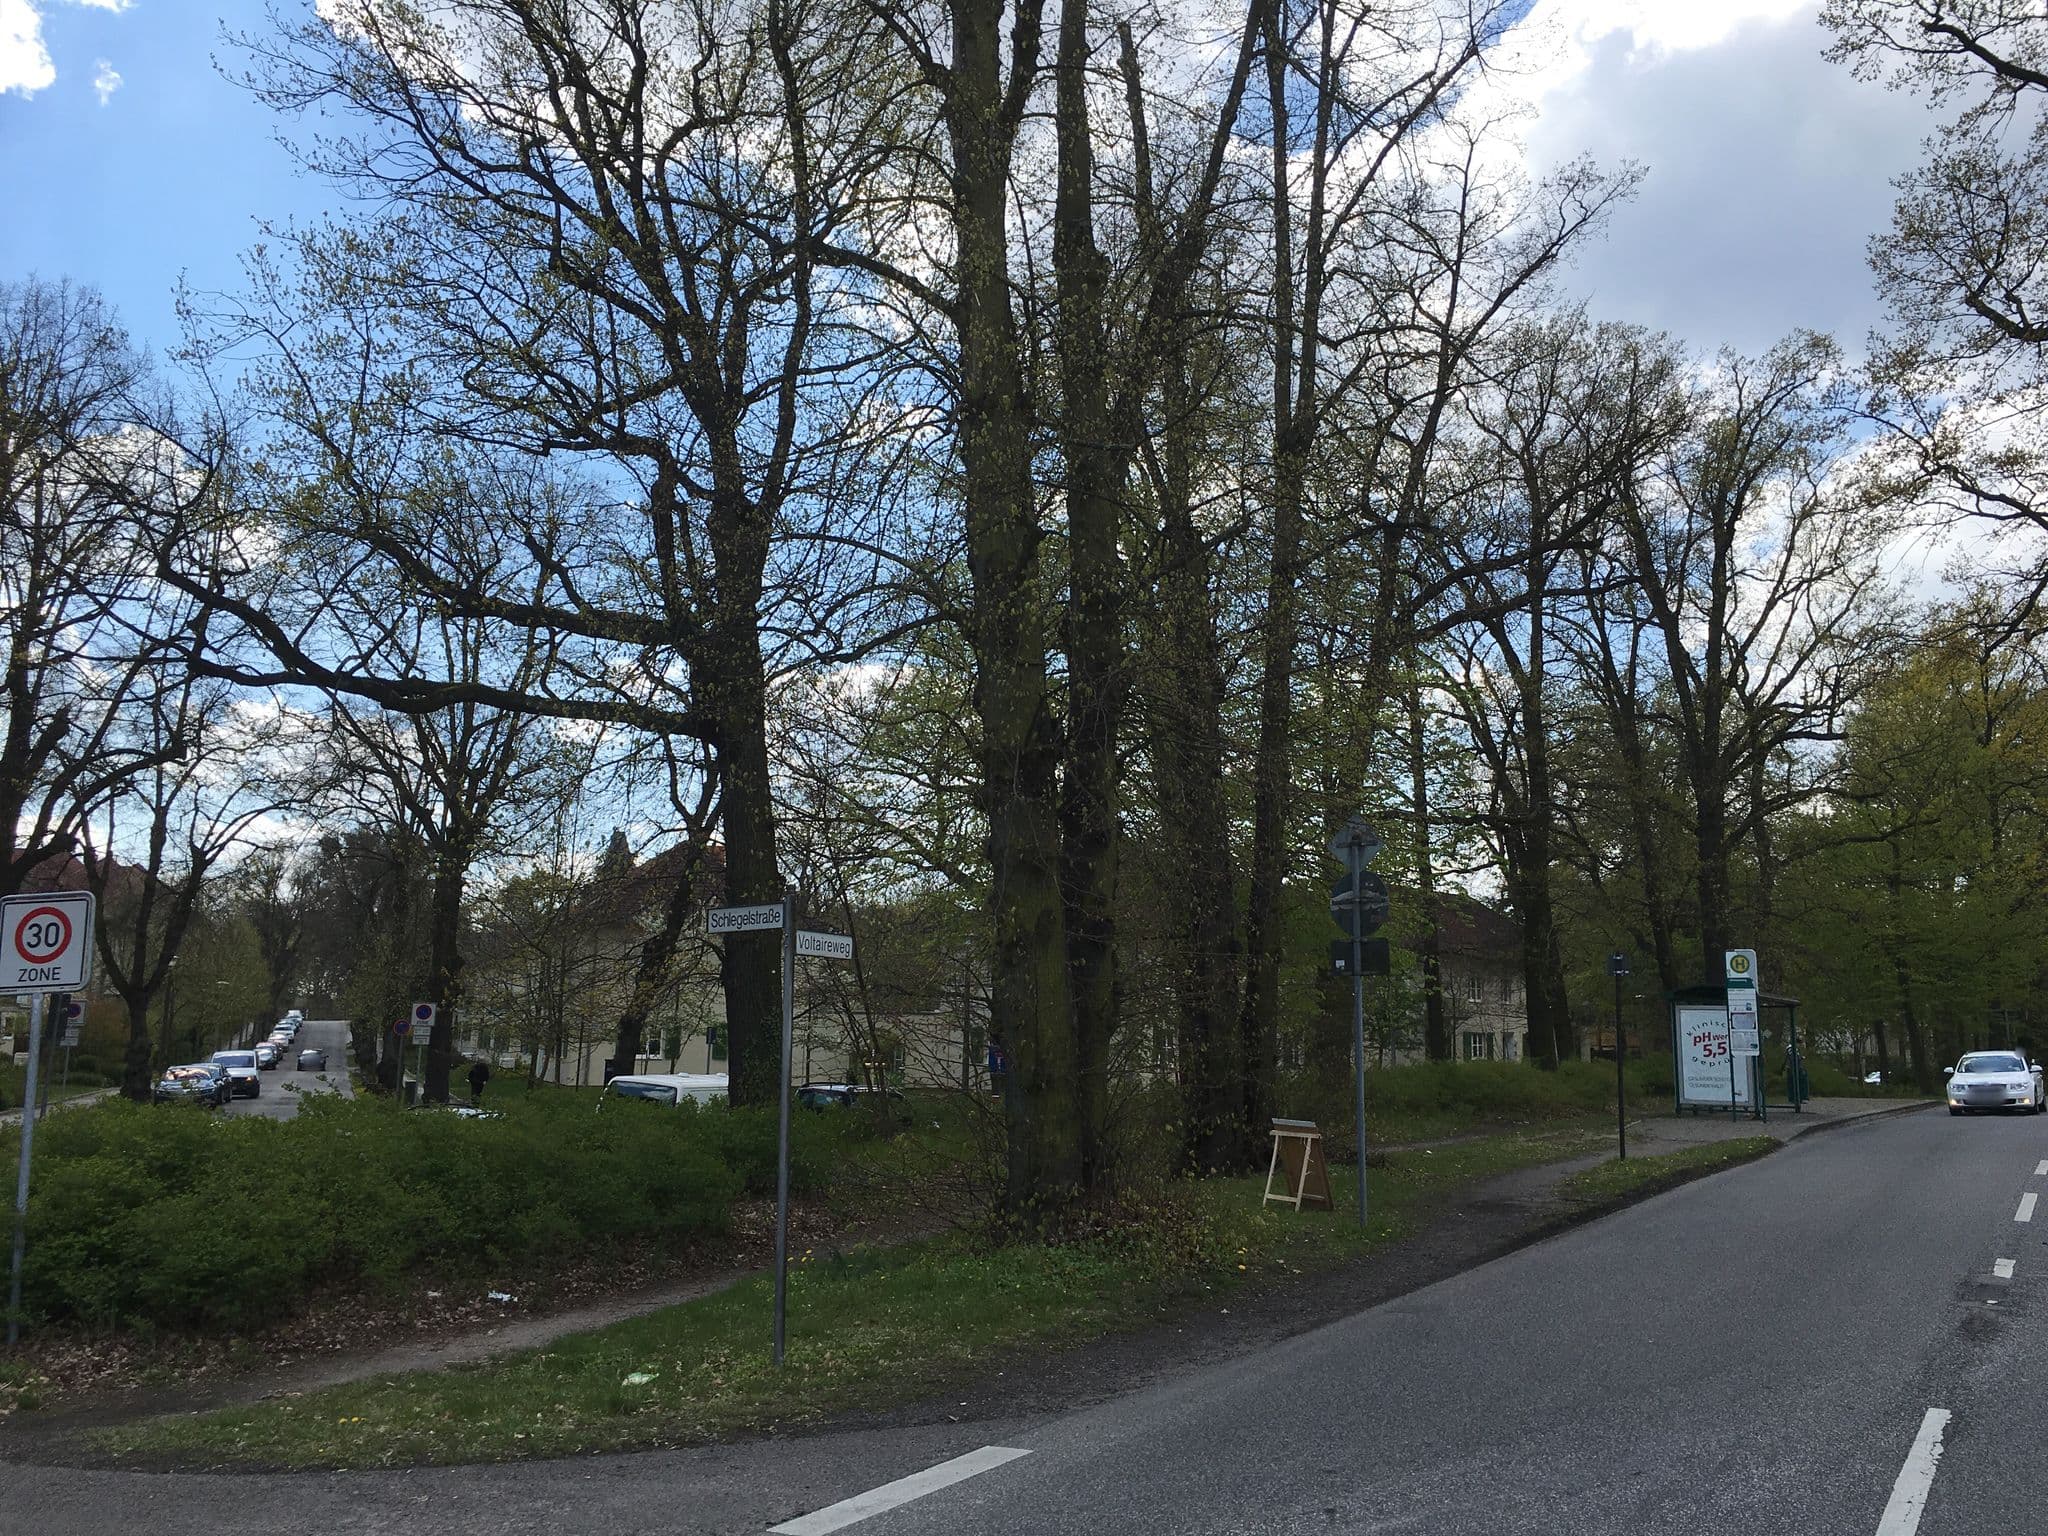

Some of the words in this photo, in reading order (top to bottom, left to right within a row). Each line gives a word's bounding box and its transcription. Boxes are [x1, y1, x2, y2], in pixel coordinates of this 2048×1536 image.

[710, 908, 781, 930] Schlegelstraße
[26, 922, 60, 949] 30
[798, 933, 851, 958] Voltaireweg
[17, 966, 62, 983] ZONE
[1686, 1019, 1727, 1037] klinisc
[1703, 1041, 1728, 1059] 5,5
[1692, 1056, 1730, 1068] geprü
